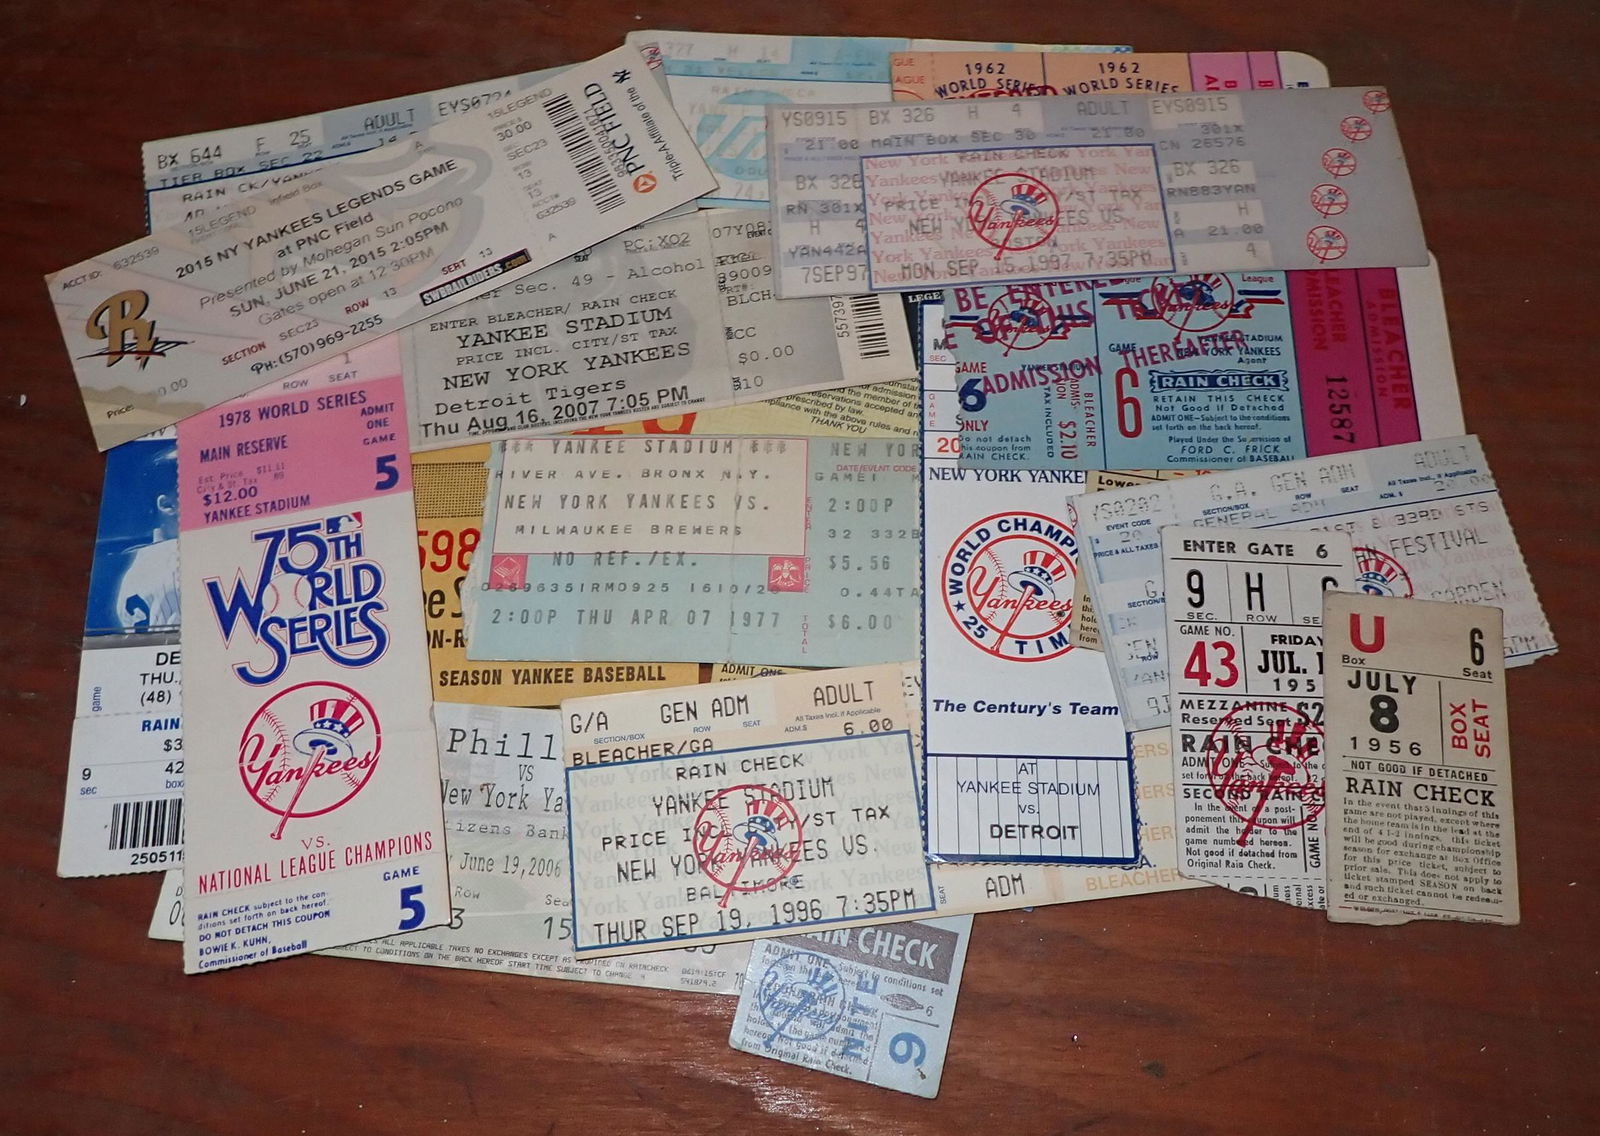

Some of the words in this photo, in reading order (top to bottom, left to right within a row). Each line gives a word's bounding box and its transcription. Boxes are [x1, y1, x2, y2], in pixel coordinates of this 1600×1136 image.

[965, 63, 1006, 75] 1962
[1099, 62, 1140, 74] 1962
[935, 78, 987, 97] WORLD
[1063, 78, 1119, 96] WORLD
[364, 108, 415, 131] ADULT
[584, 82, 622, 135] FIELD
[869, 110, 891, 125] BX
[902, 108, 935, 123] 326
[1077, 100, 1130, 116] ADULT
[191, 145, 223, 162] 644
[871, 136, 915, 148] MAIN
[611, 134, 644, 176] PNC
[176, 255, 213, 279] 2015
[244, 212, 323, 250] YANKEES
[327, 180, 405, 218] LEGENDS
[410, 159, 458, 185] GAME
[296, 229, 331, 251] PNC
[334, 212, 374, 234] Field
[199, 271, 276, 309] Presented
[302, 233, 371, 269] Mohegan
[408, 198, 464, 224] Pocono
[274, 274, 318, 300] JUNE
[390, 221, 449, 251] 2:05PM
[627, 258, 705, 280] Alcohol
[515, 281, 557, 295] Sec.
[572, 274, 593, 287] 49
[429, 317, 478, 332] ENTER
[582, 297, 620, 311] RAIN
[629, 289, 677, 305] CHECK
[456, 323, 548, 348] YANKEE
[565, 306, 672, 334] STADIUM
[456, 350, 503, 366] PRICE
[572, 332, 639, 350] CITY/ST
[649, 326, 678, 338] TAX
[1118, 329, 1248, 369] THEREAFTER
[1379, 288, 1412, 410] BLEACHER
[443, 371, 490, 390] NEW
[505, 361, 568, 382] YORK
[584, 342, 691, 371] YANKEES
[983, 356, 1103, 394] ADMISSION
[1161, 375, 1209, 389] RAIN
[1216, 374, 1277, 388] CHECK
[435, 392, 532, 416] Detroit
[545, 378, 626, 400] Tigers
[1115, 367, 1143, 438] 6
[1153, 395, 1196, 403] RETAIN
[1246, 394, 1285, 403] CHECK
[219, 410, 251, 428] 1978
[258, 400, 309, 421] WORLD
[317, 390, 367, 411] SERIES
[360, 403, 395, 417] ADMIT
[422, 417, 459, 438] Thu
[467, 411, 508, 431] Aug
[553, 400, 599, 420] 2007
[606, 393, 650, 412] 7:05
[657, 385, 690, 402] PM
[1326, 376, 1355, 444] 12587
[367, 418, 390, 430] ONE
[810, 415, 844, 429] THANK
[200, 446, 231, 463] MAIN
[236, 435, 288, 458] RESERVE
[363, 432, 396, 446] GAME
[552, 439, 626, 454] YANKEE
[644, 439, 733, 454] STADIUM
[1181, 445, 1213, 454] FORD
[1245, 445, 1280, 454] FRICK
[374, 454, 399, 491] 5
[495, 470, 557, 479] RIVER
[575, 470, 624, 479] AVE.
[641, 469, 705, 479] BRONX
[929, 467, 966, 481] NEW
[973, 468, 1022, 482] YORK
[203, 486, 258, 507] $12.00
[504, 494, 542, 509] NEW
[560, 494, 608, 509] YORK
[627, 494, 715, 509] YANKEES
[204, 505, 250, 524] YANKEE
[255, 494, 311, 515] STADIUM
[515, 525, 633, 535] MILWAUKEE
[650, 525, 742, 535] BREWERS
[1183, 540, 1236, 554] ENTER
[1247, 543, 1294, 556] GATE
[1316, 544, 1328, 558] 6
[1186, 568, 1205, 609] 9
[1245, 571, 1266, 612] H
[577, 609, 612, 625] THU
[631, 609, 669, 625] APR
[686, 609, 711, 625] 07
[730, 610, 780, 628] 1977
[1246, 614, 1278, 623] ROW
[1180, 625, 1210, 636] GAME
[1215, 626, 1235, 637] NO.
[1350, 613, 1385, 653] U
[236, 602, 388, 685] SERIES
[1469, 627, 1485, 666] 6
[1184, 640, 1239, 688] 43
[1257, 649, 1307, 674] JUL.
[1342, 654, 1366, 665] Box
[440, 669, 502, 687] SEASON
[512, 667, 574, 685] YANKEE
[583, 665, 666, 683] BASEBALL
[1348, 670, 1416, 695] JULY
[1463, 667, 1493, 680] Seat
[92, 686, 103, 712] game
[140, 690, 171, 706] (48)
[813, 681, 874, 706] ADULT
[660, 700, 697, 724] GEN
[712, 695, 749, 718] ADM
[933, 699, 967, 713] The
[973, 700, 1062, 718] Century's
[1069, 702, 1119, 716] Team
[1180, 699, 1288, 713] MEZZANINE
[1370, 694, 1400, 734] 8
[142, 718, 181, 732] RAIN
[570, 711, 608, 734] G/A
[1450, 703, 1468, 750] BOX
[1472, 698, 1491, 758] SEAT
[1350, 736, 1422, 756] 1956
[676, 761, 726, 781] RAIN
[741, 754, 804, 773] CHECK
[1018, 763, 1037, 775] AT
[1351, 760, 1373, 772] NOT
[1378, 762, 1406, 774] GOOD
[1429, 768, 1488, 782] DETACHED
[80, 785, 97, 795] sec
[484, 784, 529, 810] York
[957, 781, 1021, 795] YANKEE
[1028, 782, 1100, 796] STADIUM
[1345, 777, 1403, 798] RAIN
[1414, 784, 1496, 808] CHECK
[852, 806, 890, 821] TAX
[602, 831, 666, 852] PRICE
[990, 824, 1079, 840] DETROIT
[199, 864, 271, 894] NATIONAL
[280, 850, 336, 878] LEAGUE
[345, 831, 433, 866] CHAMPIONS
[383, 866, 420, 881] GAME
[460, 853, 494, 873] June
[617, 858, 656, 883] NEW
[454, 886, 480, 899] Row
[985, 873, 1025, 899] ADM
[398, 884, 426, 931] 5
[594, 919, 647, 944] THUR
[662, 913, 699, 938] SEP
[770, 899, 822, 925] 1996
[836, 888, 916, 917] 7:35PM
[858, 927, 939, 970] CHECK
